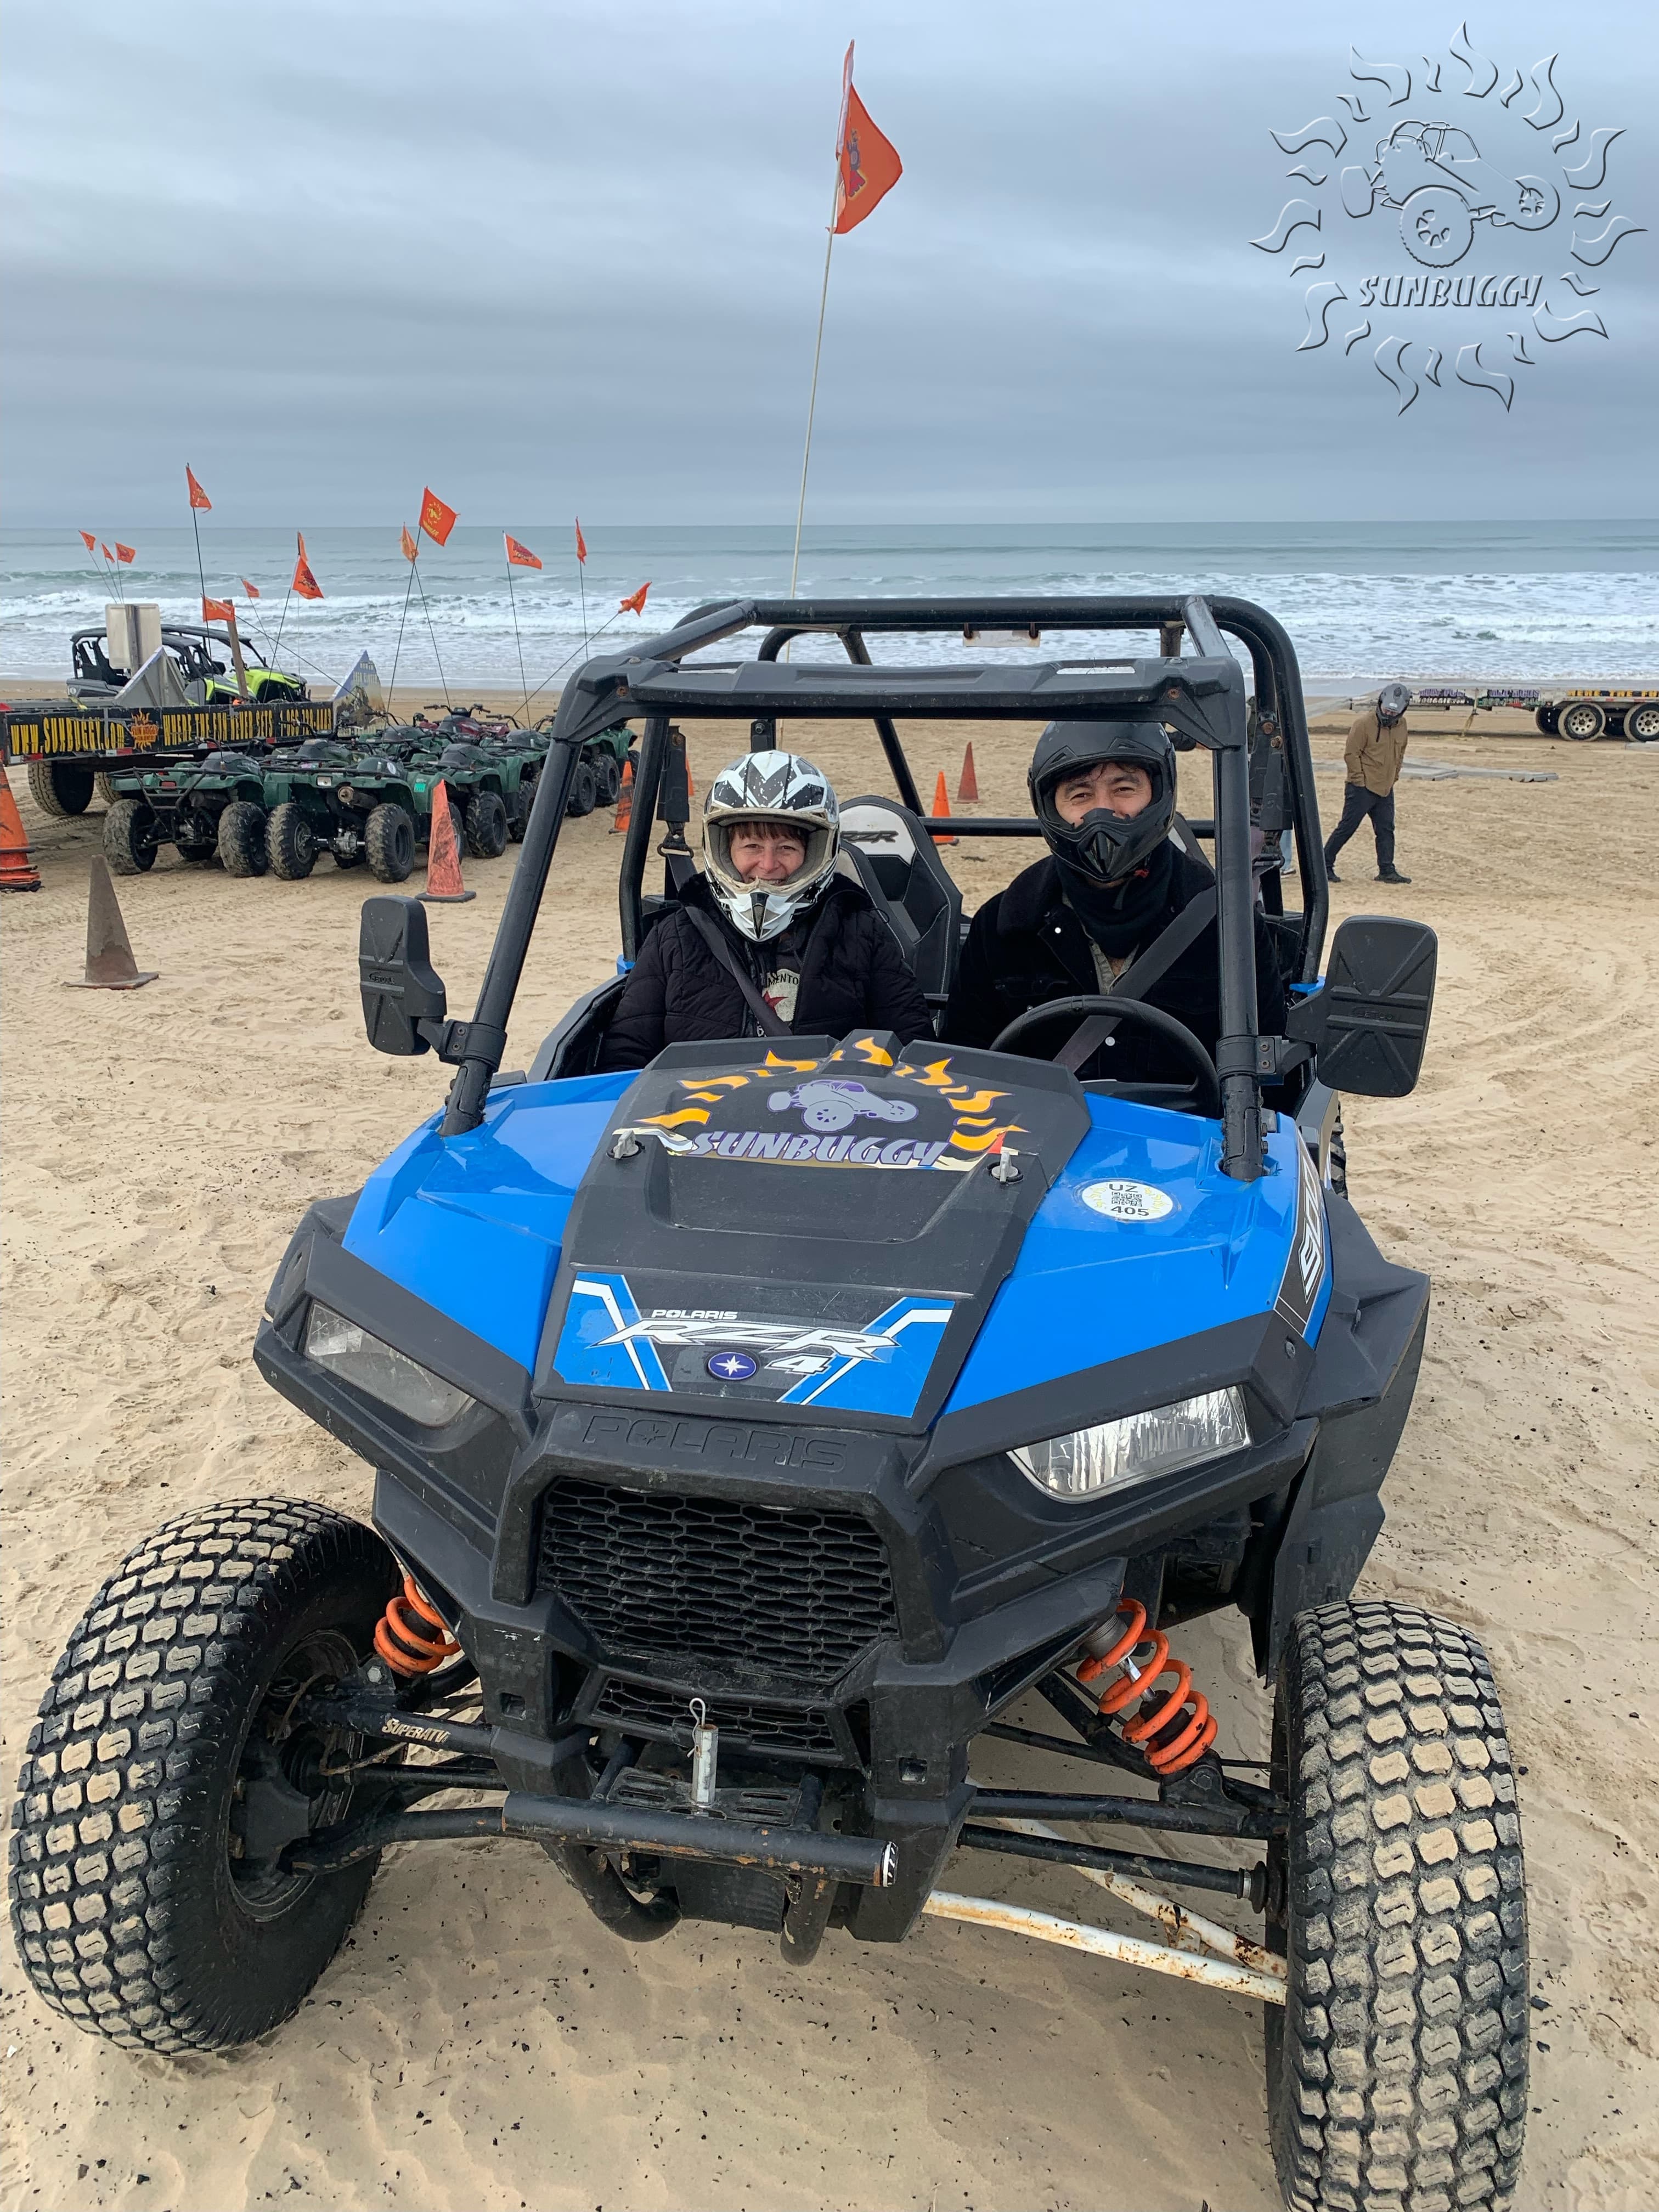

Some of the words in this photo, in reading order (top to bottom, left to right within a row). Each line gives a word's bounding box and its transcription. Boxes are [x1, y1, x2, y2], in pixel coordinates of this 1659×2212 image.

[840, 830, 899, 844] RZR
[768, 973, 799, 987] MENTO
[687, 1130, 951, 1166] SUNBUGGY
[1109, 1183, 1138, 1193] UZ
[1110, 1206, 1149, 1216] 405
[651, 1310, 738, 1320] POLARIS
[587, 1318, 901, 1362] RZR
[765, 1354, 833, 1375] 4
[583, 1415, 847, 1473] POLARIS
